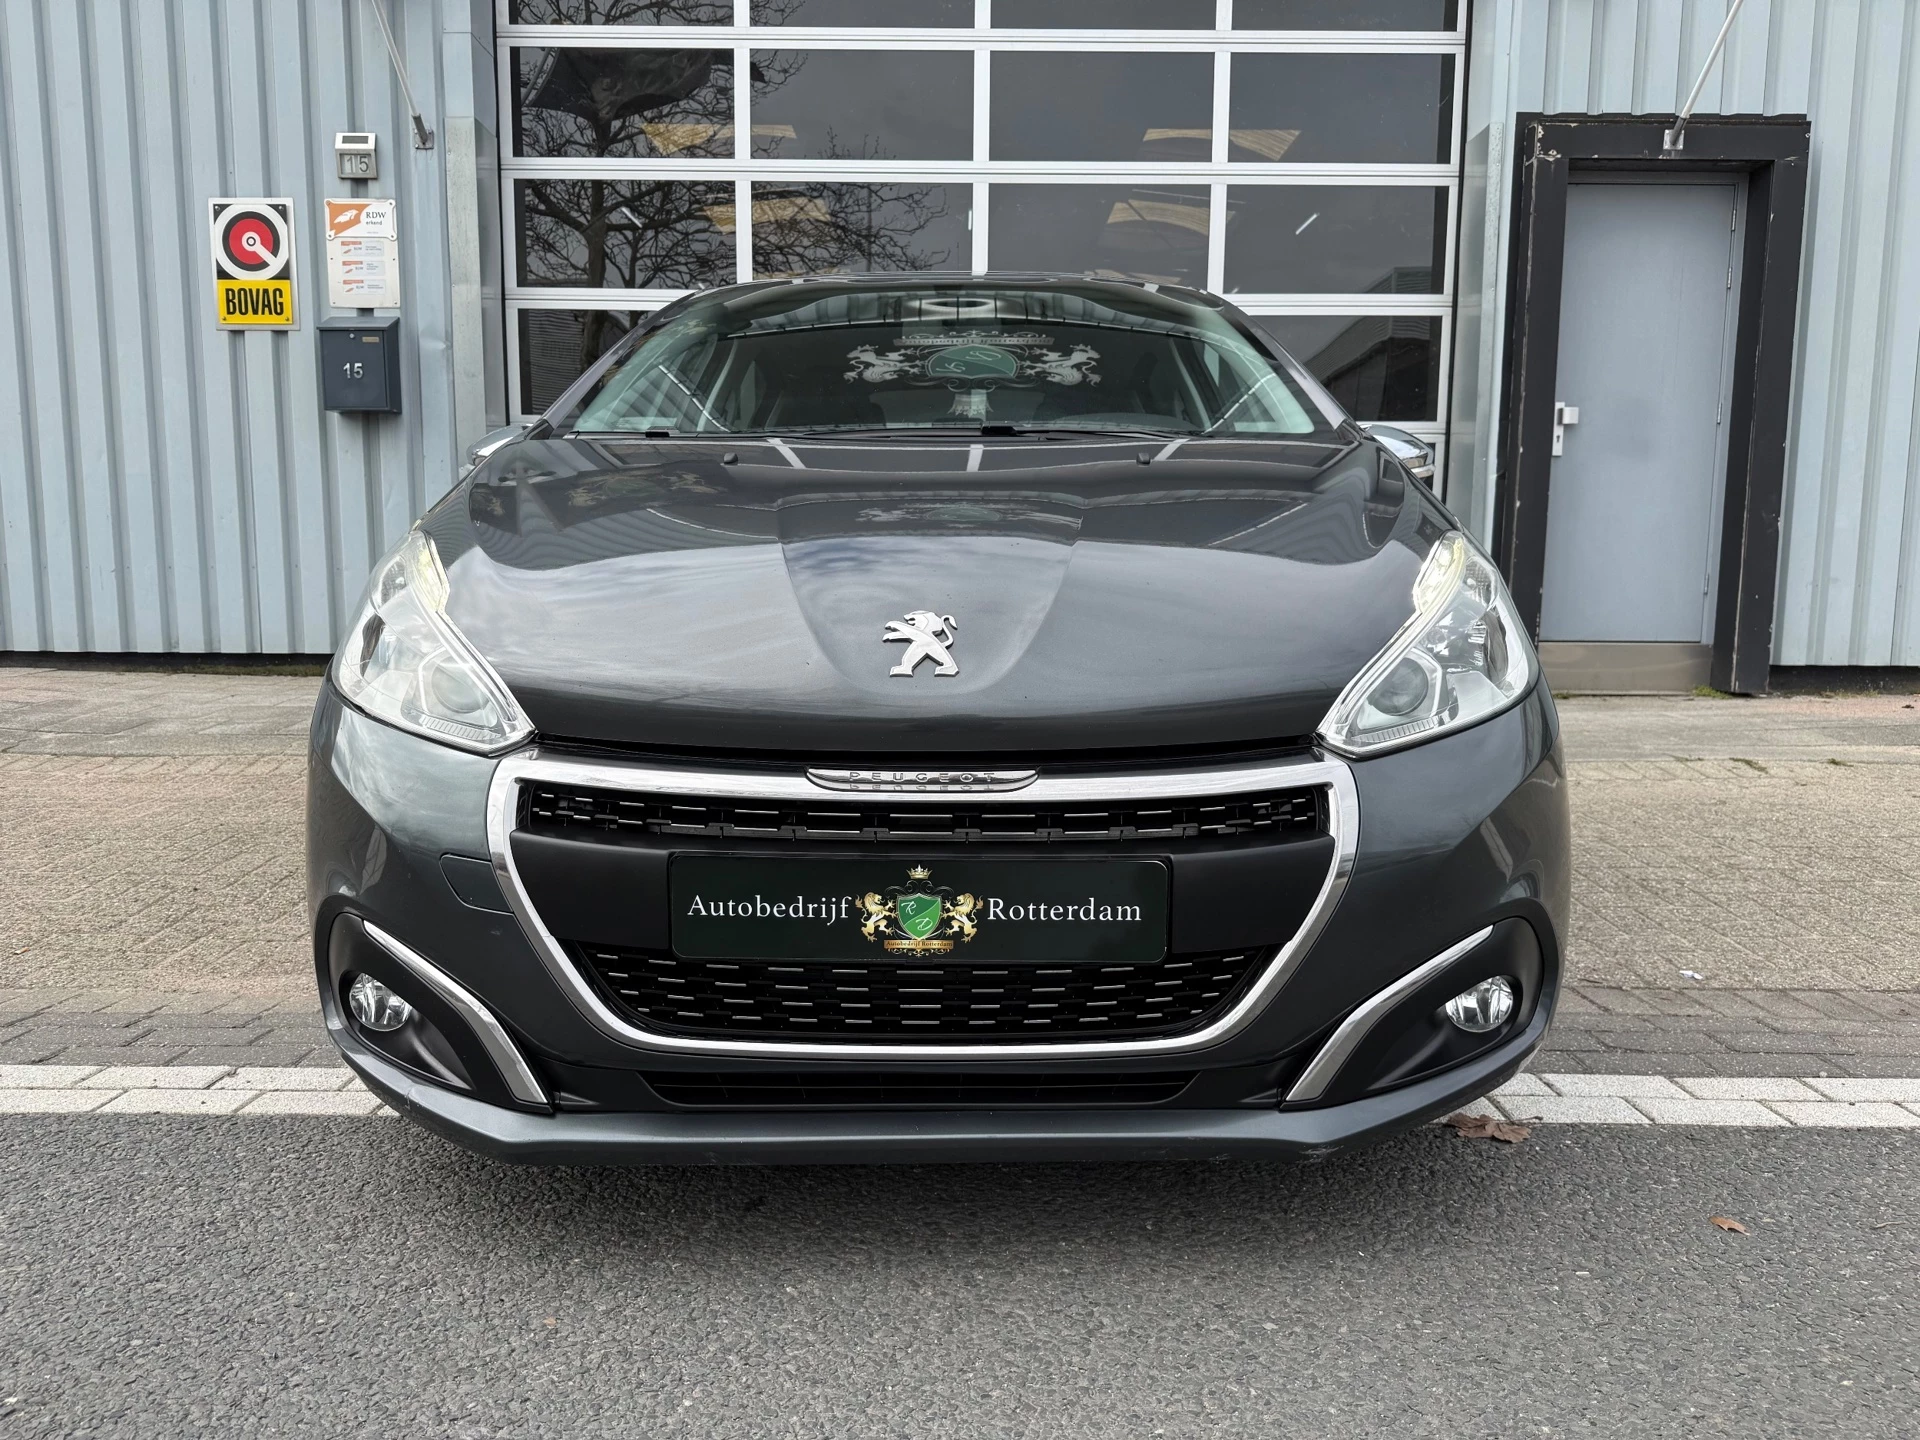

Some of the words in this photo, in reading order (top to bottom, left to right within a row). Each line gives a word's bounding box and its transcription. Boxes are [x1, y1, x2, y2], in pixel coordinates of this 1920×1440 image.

[346, 155, 369, 174] 15
[366, 211, 386, 219] RDW
[225, 287, 284, 316] BOVAG
[343, 362, 363, 379] 15
[849, 771, 996, 782] PEUGEOT
[686, 894, 852, 926] Autobedrijf
[987, 896, 1142, 922] Rotterdam
